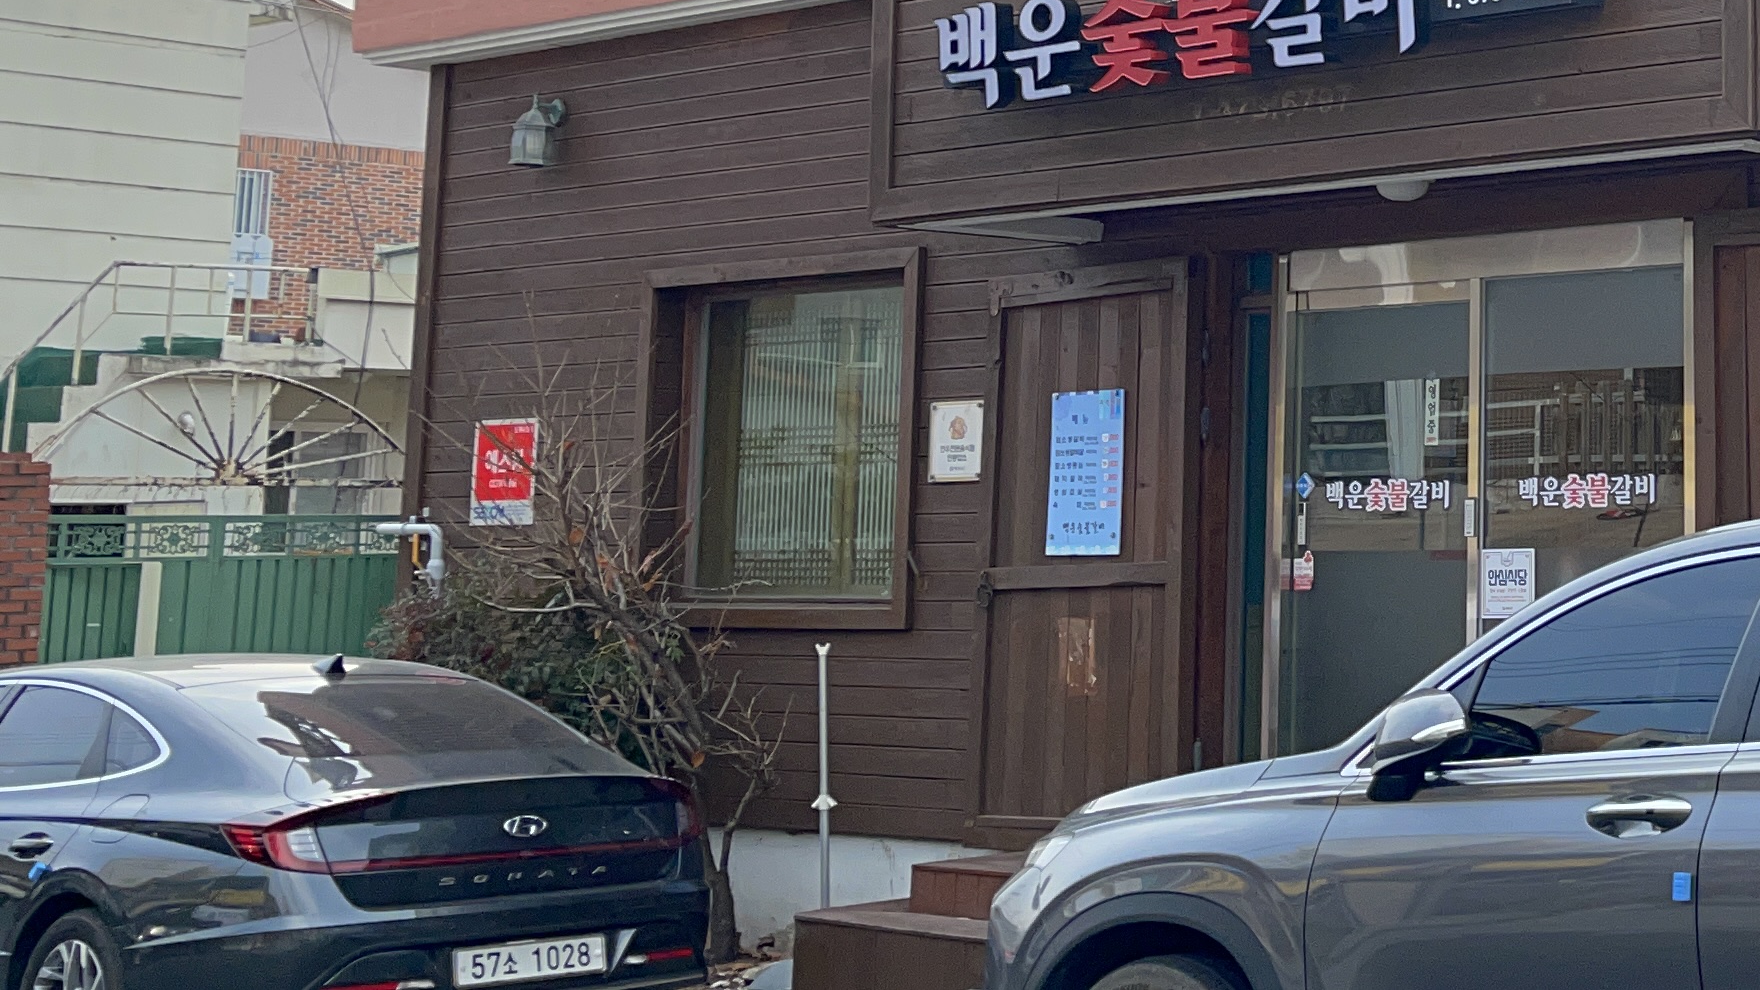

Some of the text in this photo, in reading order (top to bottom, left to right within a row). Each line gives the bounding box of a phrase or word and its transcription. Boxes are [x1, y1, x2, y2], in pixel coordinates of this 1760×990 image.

[1326, 478, 1450, 512] 백운숯불갈비
[1518, 473, 1656, 509] 백운숯불갈비
[1488, 569, 1527, 587] 안심식당
[438, 865, 607, 886] SONATA
[471, 942, 592, 980] 57소 1028
